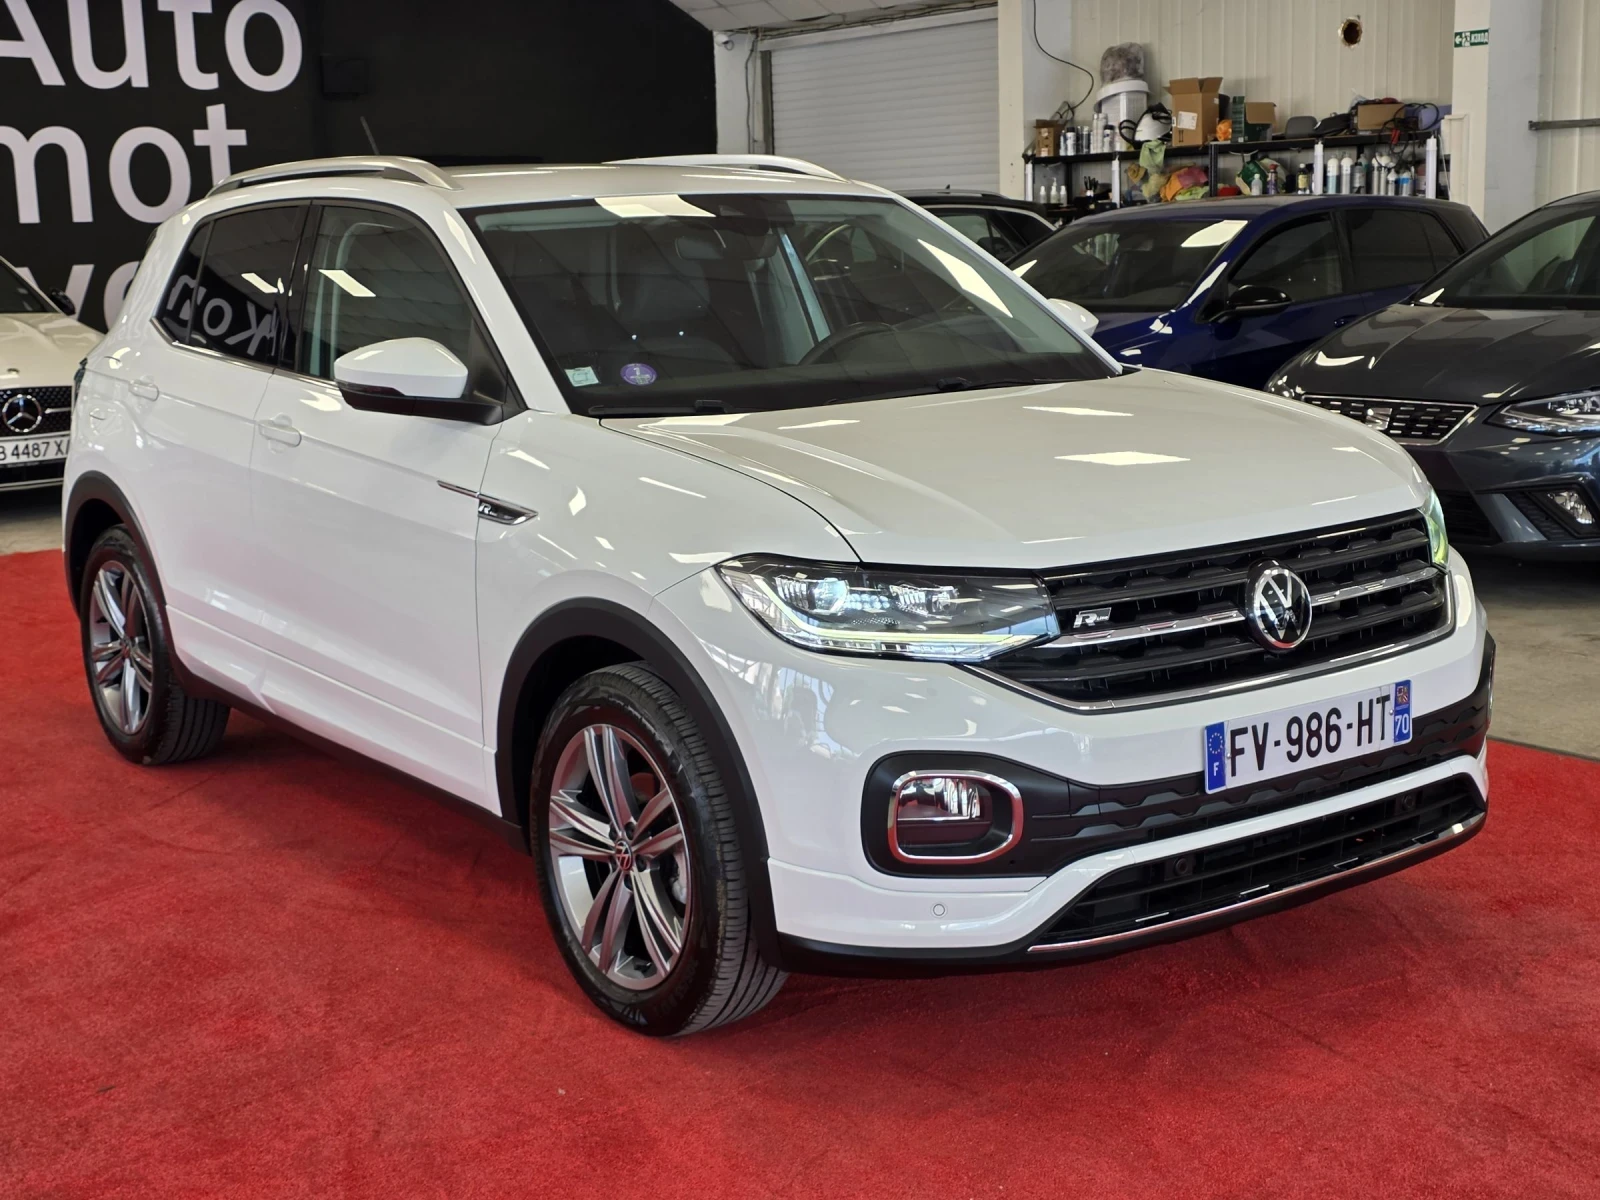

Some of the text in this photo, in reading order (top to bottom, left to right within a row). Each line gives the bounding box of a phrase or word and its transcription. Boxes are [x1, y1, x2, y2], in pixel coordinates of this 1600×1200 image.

[11, 441, 50, 460] 4487
[54, 438, 71, 456] X
[1230, 694, 1391, 777] FV-986-HT
[1394, 713, 1410, 737] 70
[1212, 761, 1220, 777] F
